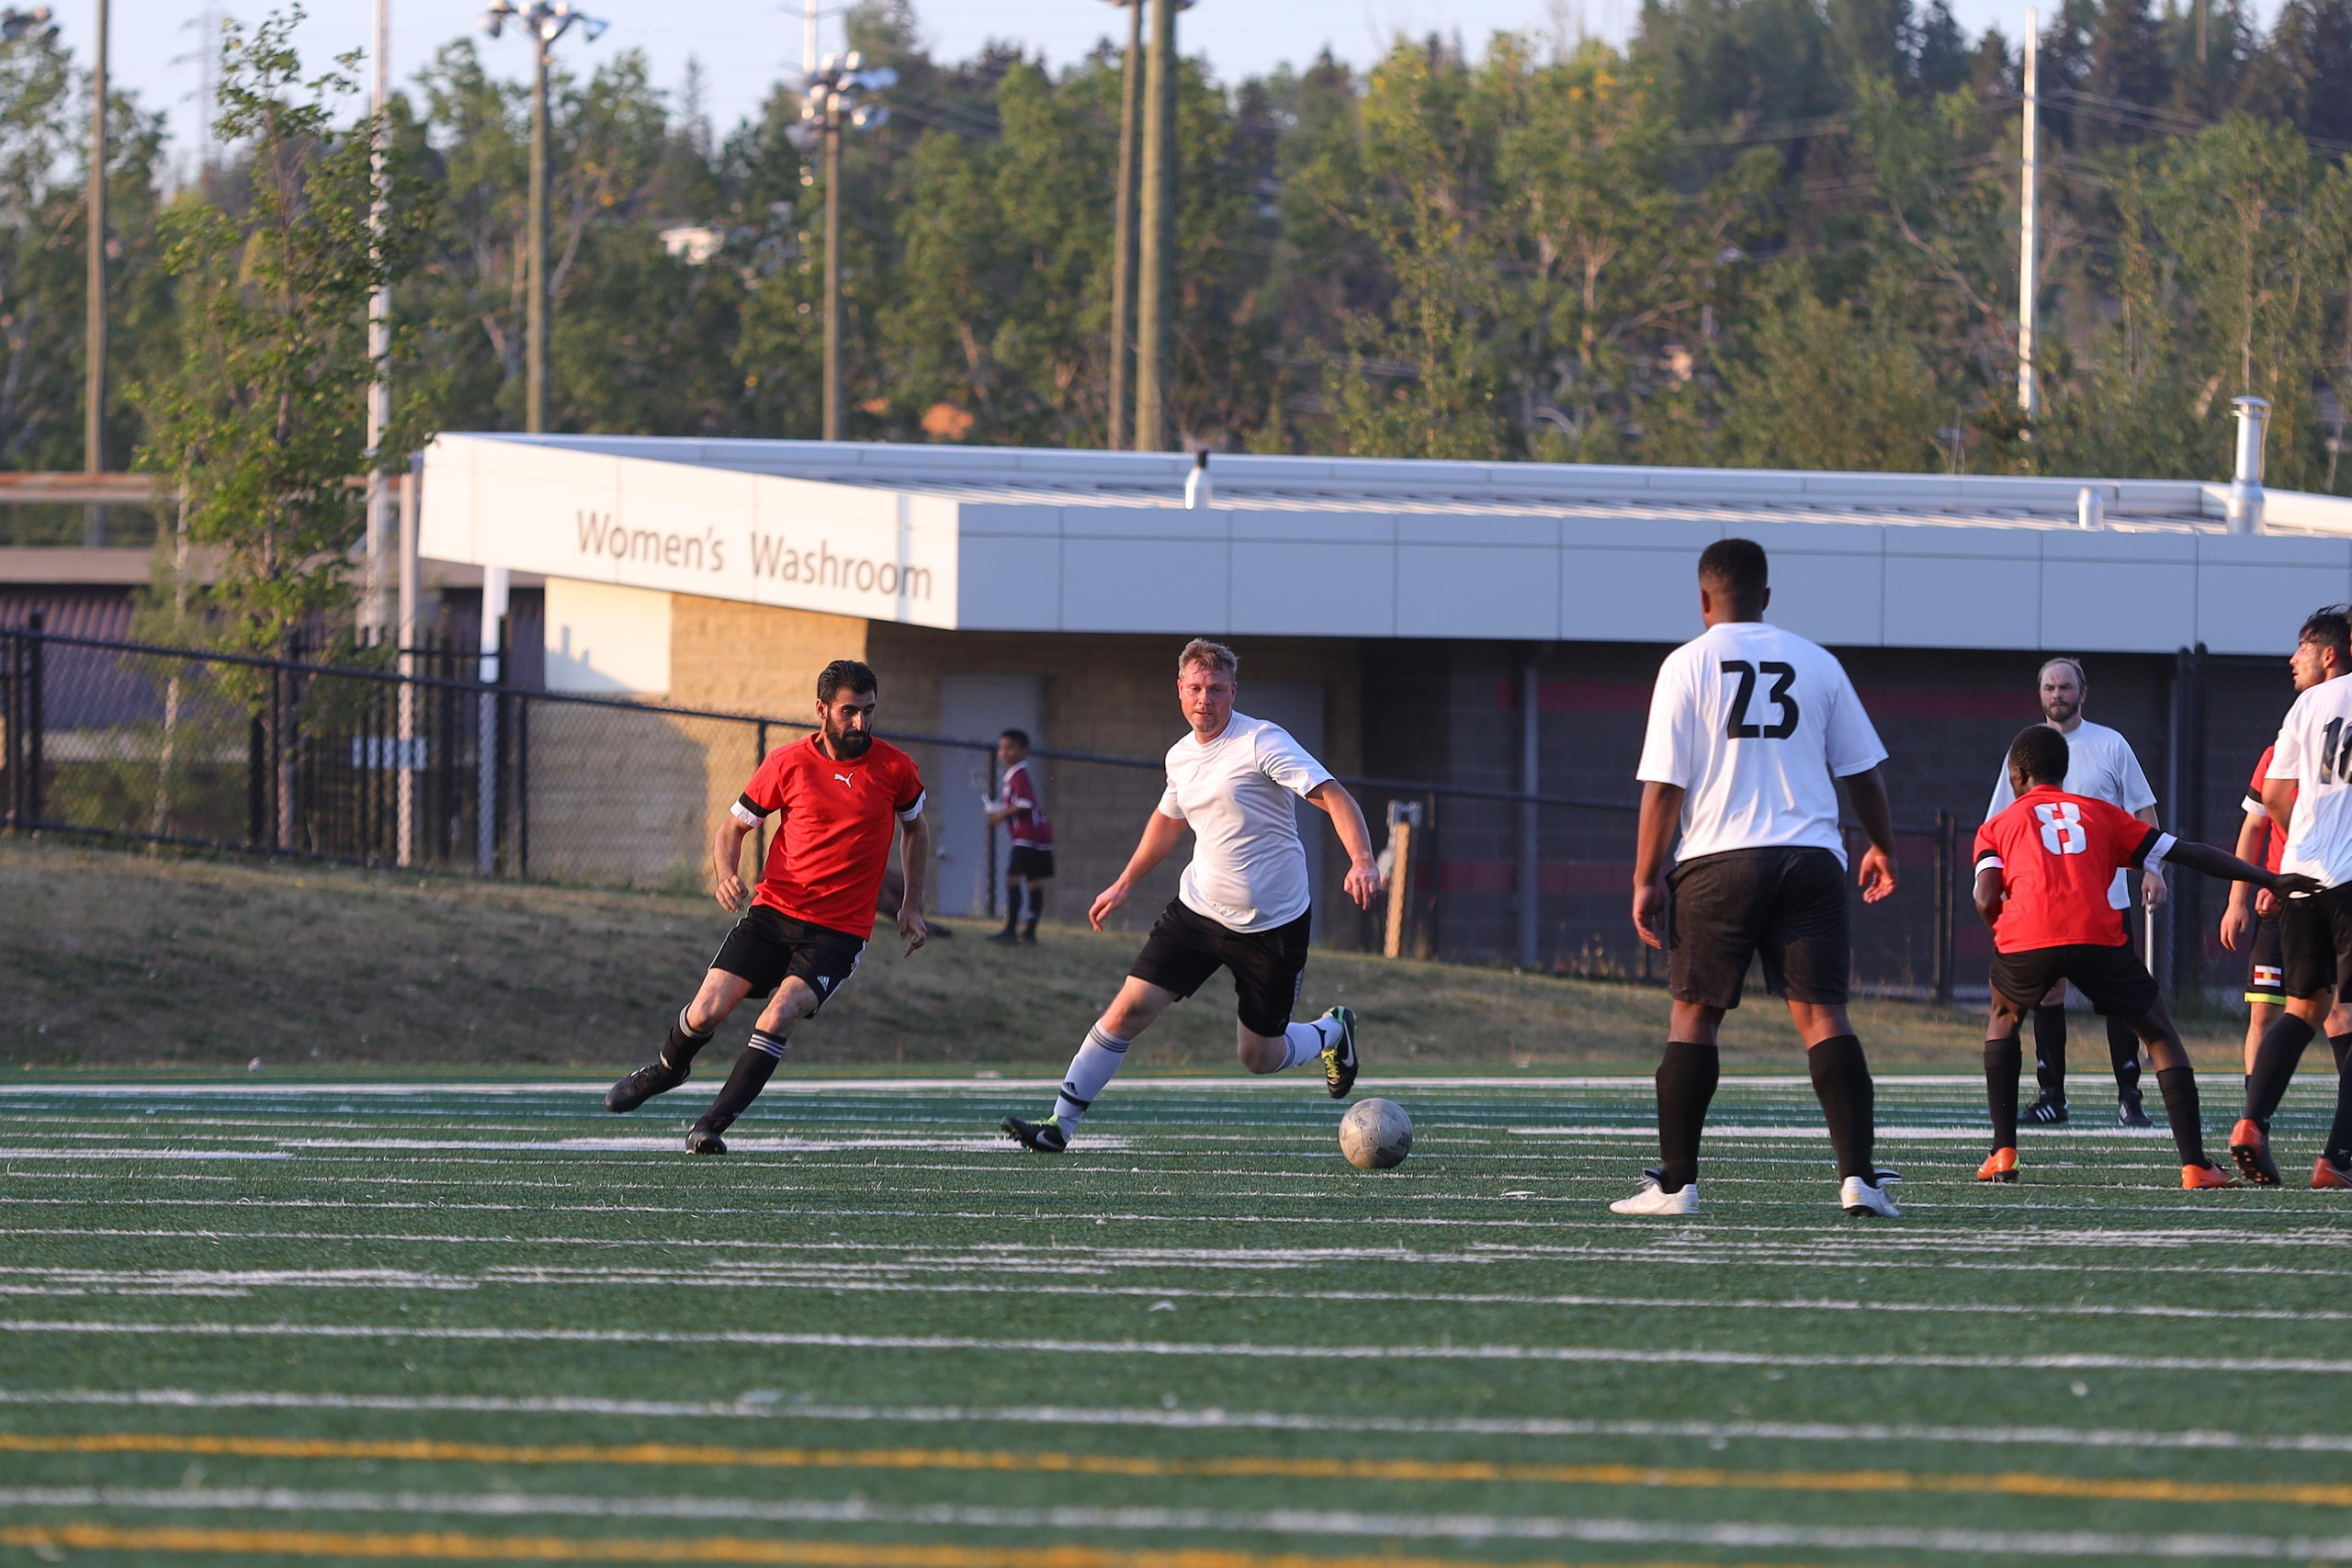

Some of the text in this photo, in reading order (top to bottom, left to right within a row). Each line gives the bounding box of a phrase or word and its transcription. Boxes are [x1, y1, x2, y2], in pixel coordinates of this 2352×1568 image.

[577, 510, 933, 601] Women's Washroom
[1721, 660, 1800, 740] 23
[2033, 801, 2087, 855] 8
